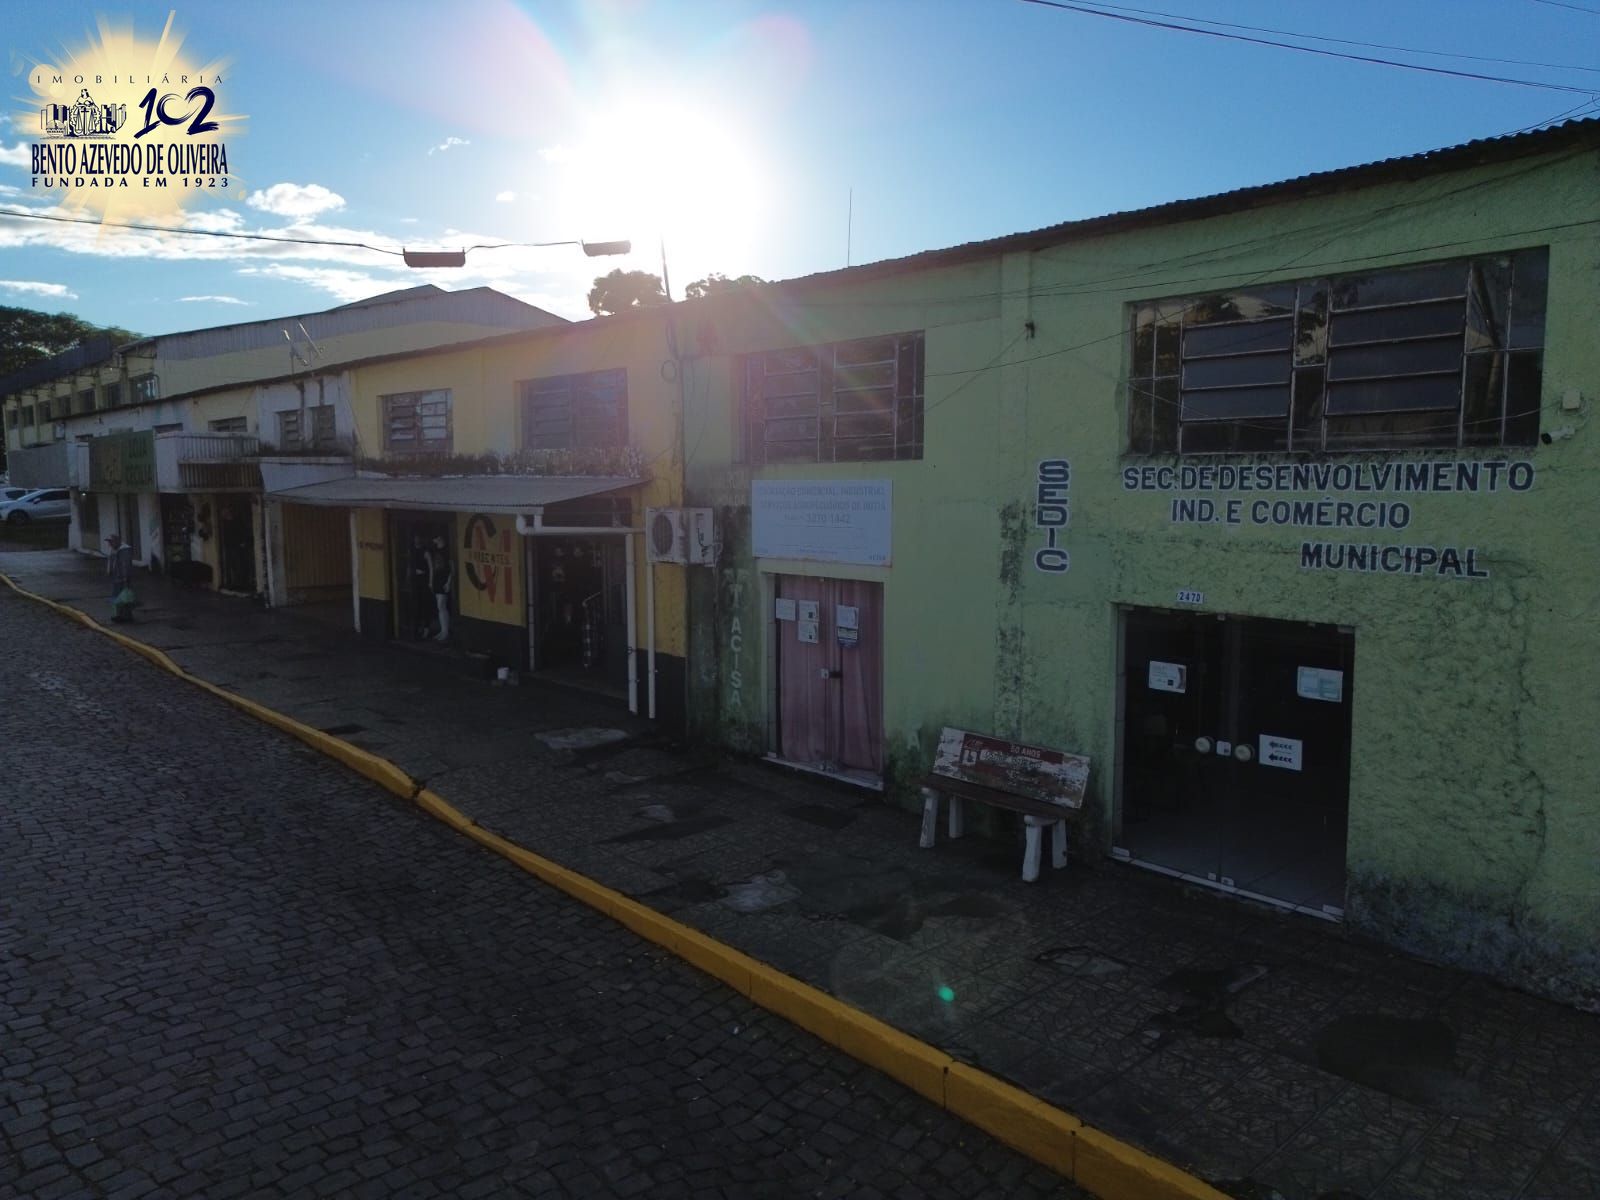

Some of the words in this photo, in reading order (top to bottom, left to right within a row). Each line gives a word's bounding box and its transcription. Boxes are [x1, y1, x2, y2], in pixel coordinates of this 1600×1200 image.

[1218, 462, 1535, 491] DESENVOLVIMENTO
[1172, 500, 1219, 522] IND.
[1227, 500, 1242, 523] E
[1252, 497, 1410, 528] COMÉRCIO
[1302, 543, 1487, 577] MUNICIPAL
